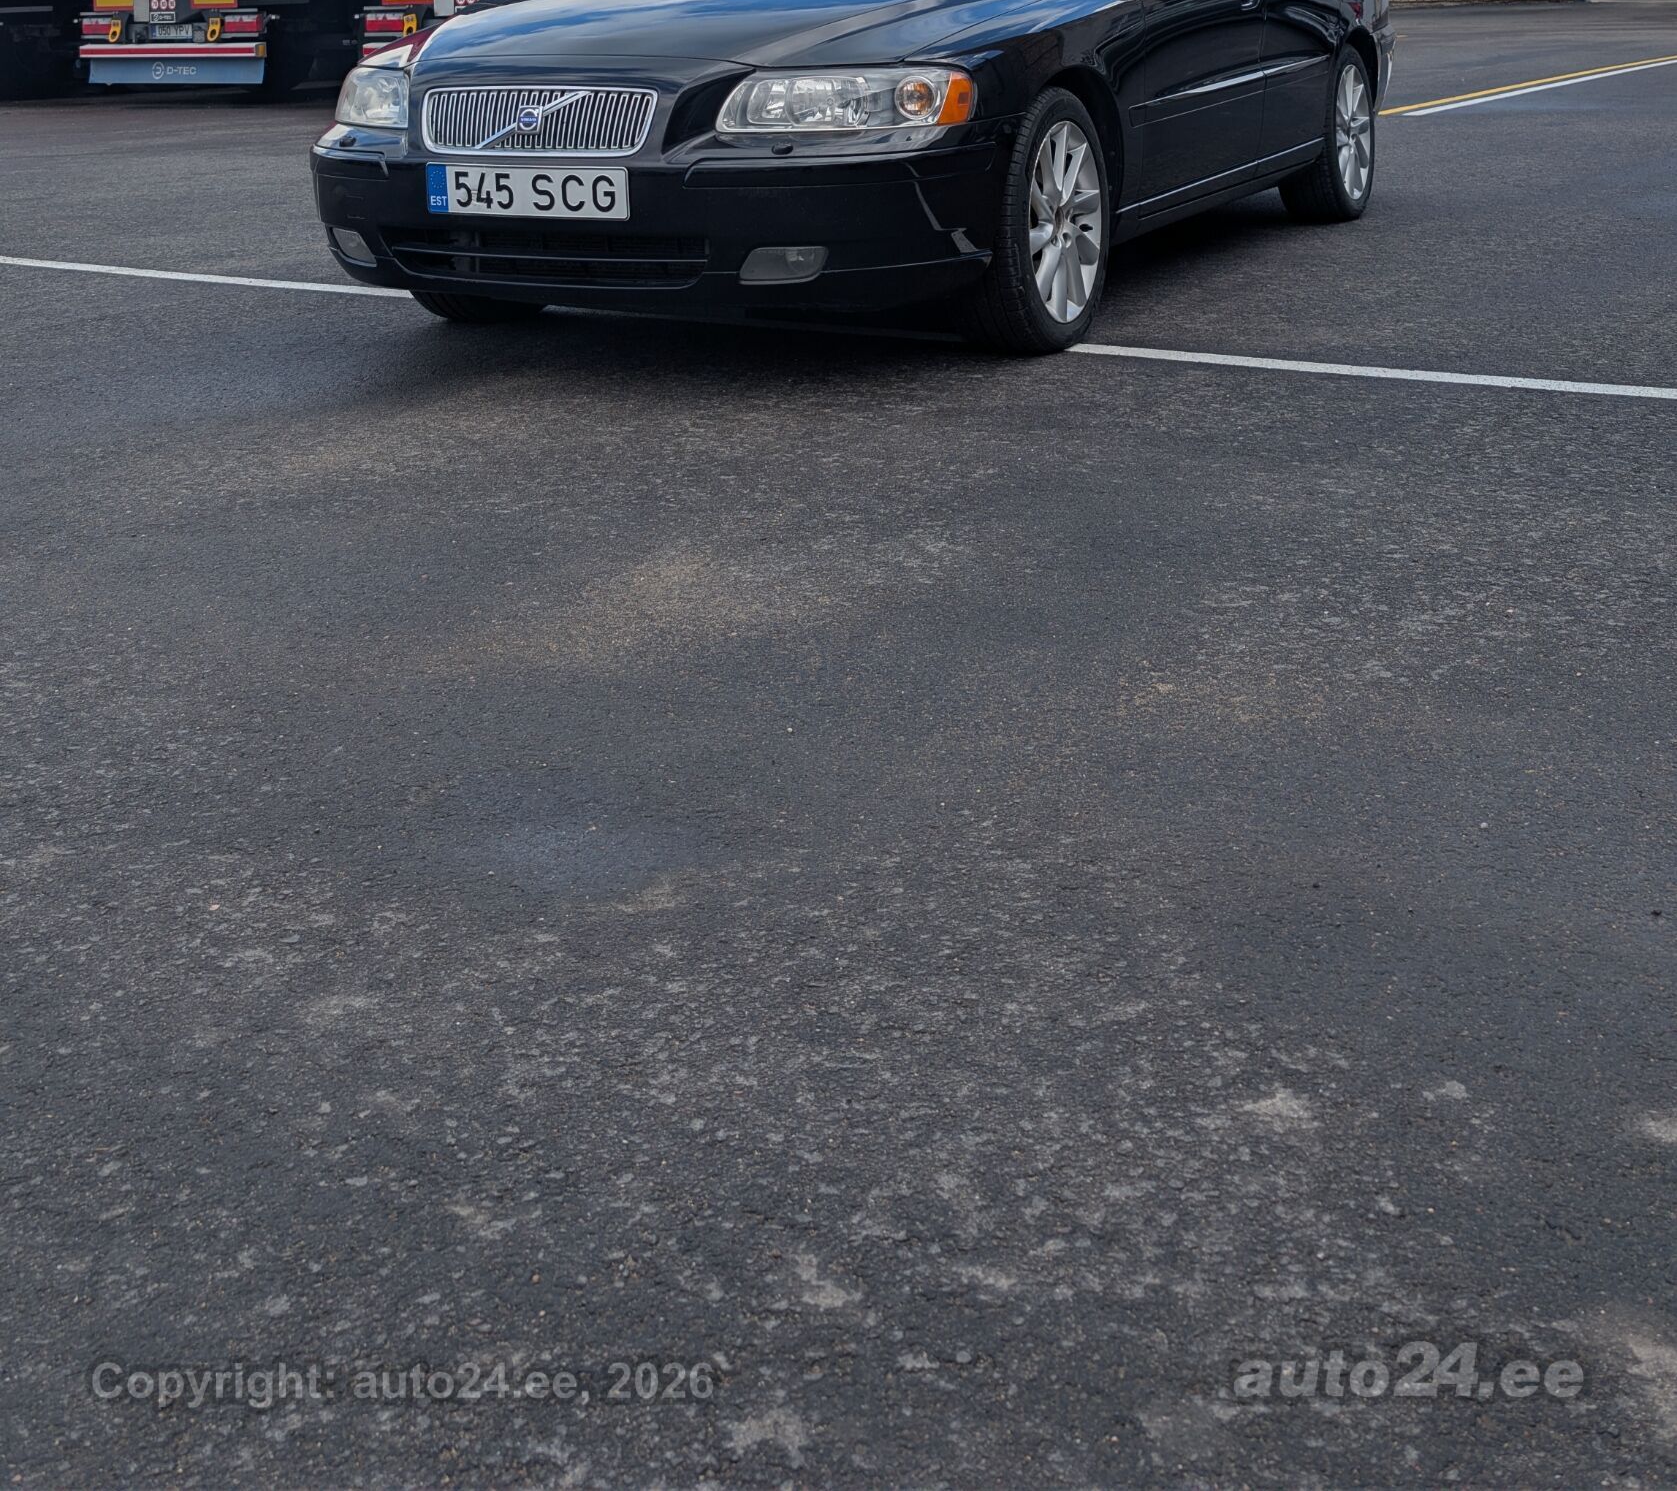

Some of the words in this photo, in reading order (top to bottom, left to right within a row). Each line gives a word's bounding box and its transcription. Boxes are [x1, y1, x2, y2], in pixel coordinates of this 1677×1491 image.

[174, 24, 191, 35] YPV
[166, 65, 197, 75] D-TEC
[430, 195, 448, 207] EST
[454, 170, 514, 210] 545
[531, 173, 617, 213] SCG
